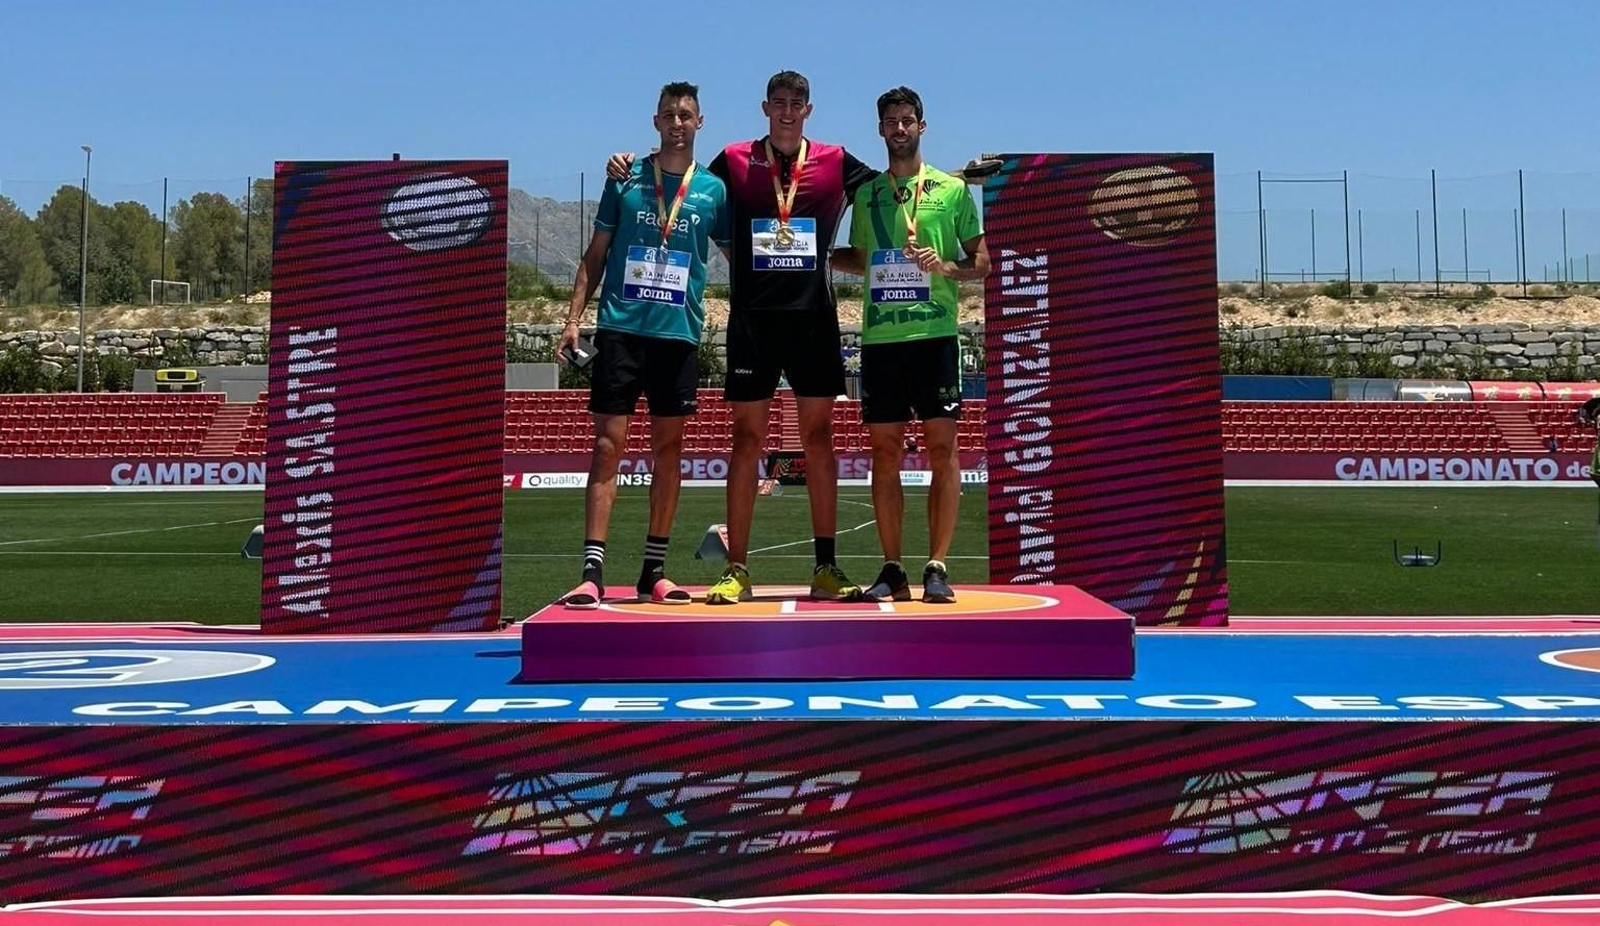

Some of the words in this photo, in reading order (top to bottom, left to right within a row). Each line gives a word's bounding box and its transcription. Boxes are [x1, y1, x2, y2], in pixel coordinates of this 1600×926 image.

[284, 326, 337, 477] SASTRE
[543, 474, 583, 486] quality
[1335, 457, 1559, 480] CAMPEONATO
[1566, 461, 1592, 477] de
[278, 492, 333, 619] Alexis
[71, 692, 1257, 716] CAMPEONATO
